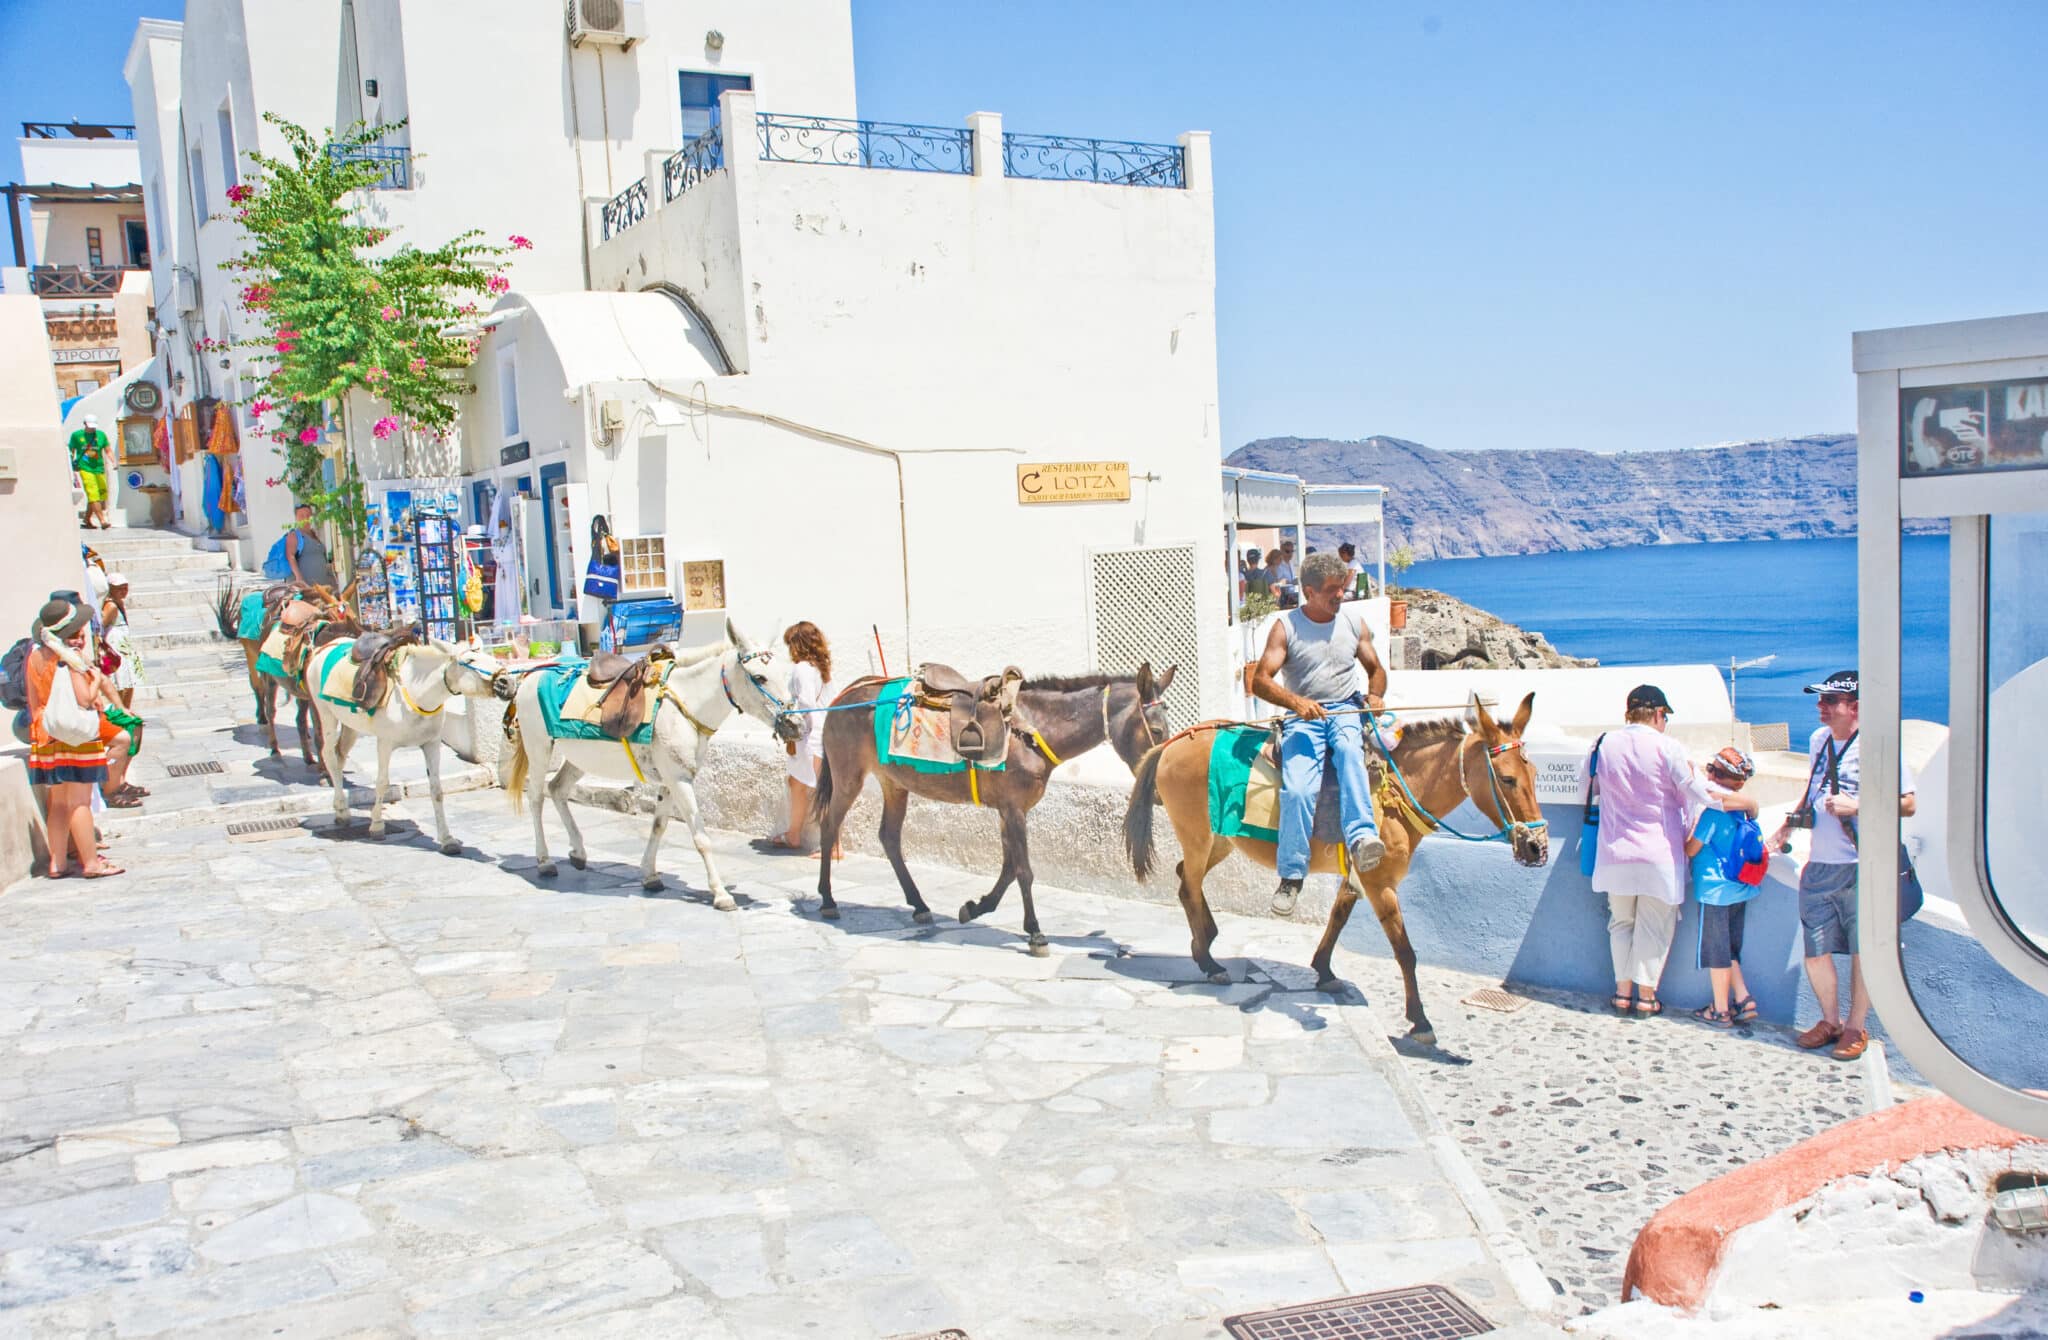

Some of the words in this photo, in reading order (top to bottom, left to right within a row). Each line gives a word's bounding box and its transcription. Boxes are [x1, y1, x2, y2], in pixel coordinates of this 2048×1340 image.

[1041, 463, 1098, 473] RESTAURANT
[1105, 462, 1128, 471] CAFE
[1054, 474, 1116, 490] LOTZA
[1547, 763, 1575, 772] ΟΔΟΣ
[1536, 774, 1579, 783] ΛΟΙΑΡΧ
